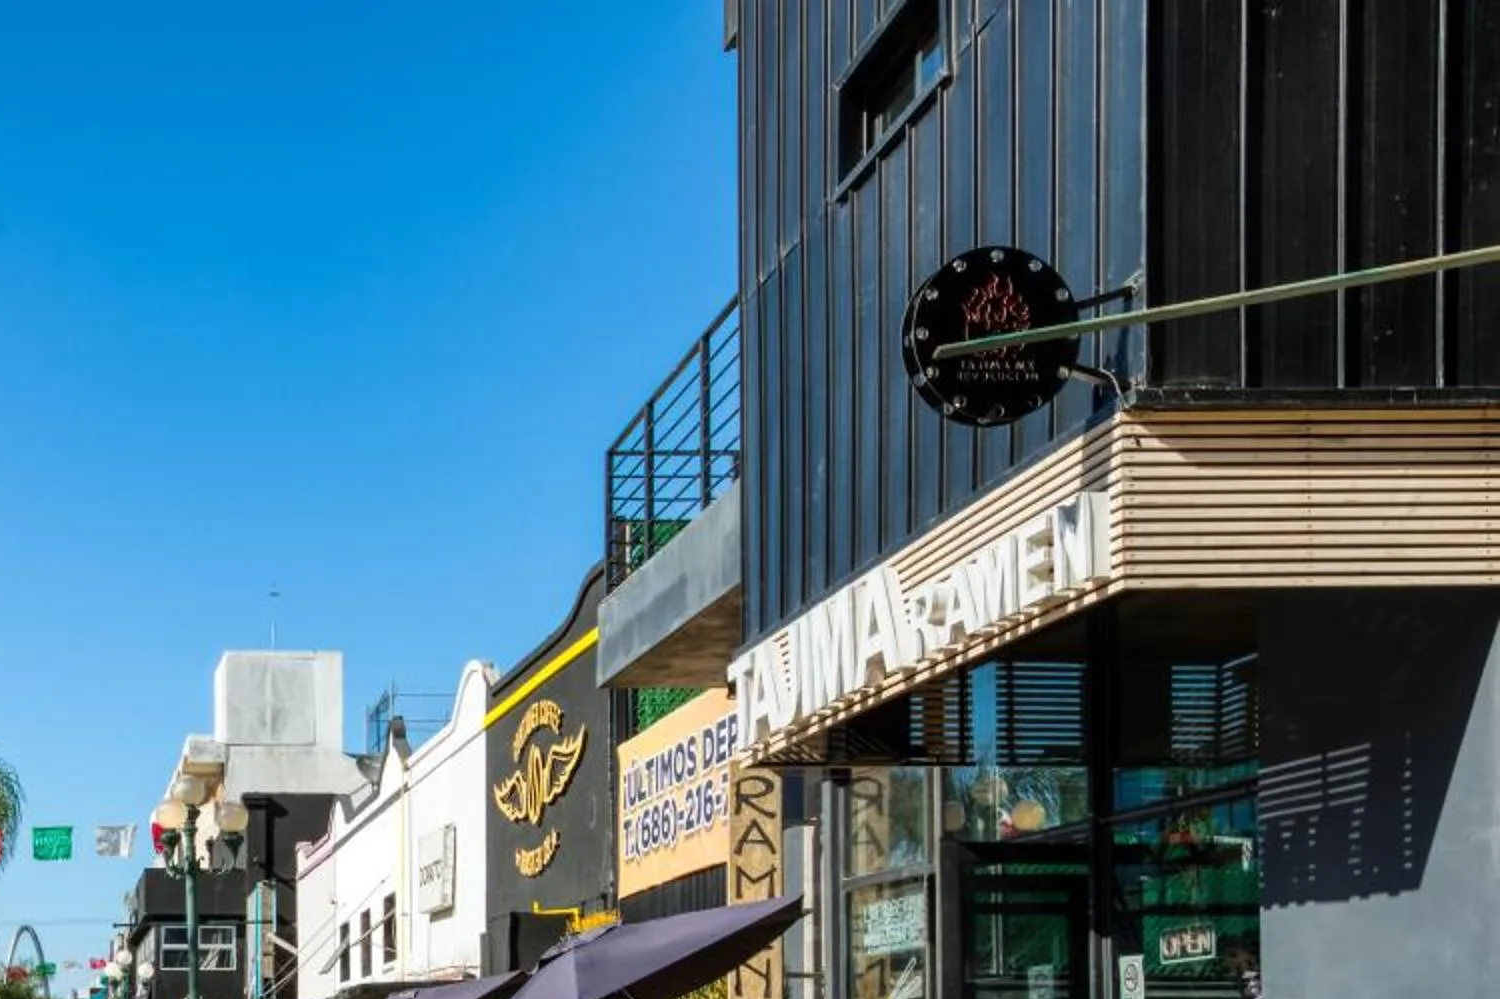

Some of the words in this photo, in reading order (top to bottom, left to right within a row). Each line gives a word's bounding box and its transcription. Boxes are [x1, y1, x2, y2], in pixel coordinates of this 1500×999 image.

[727, 565, 912, 752] TAJIMA
[905, 490, 1111, 664] RAMEN
[734, 775, 777, 998] RAMN
[1163, 929, 1212, 958] OPEN
